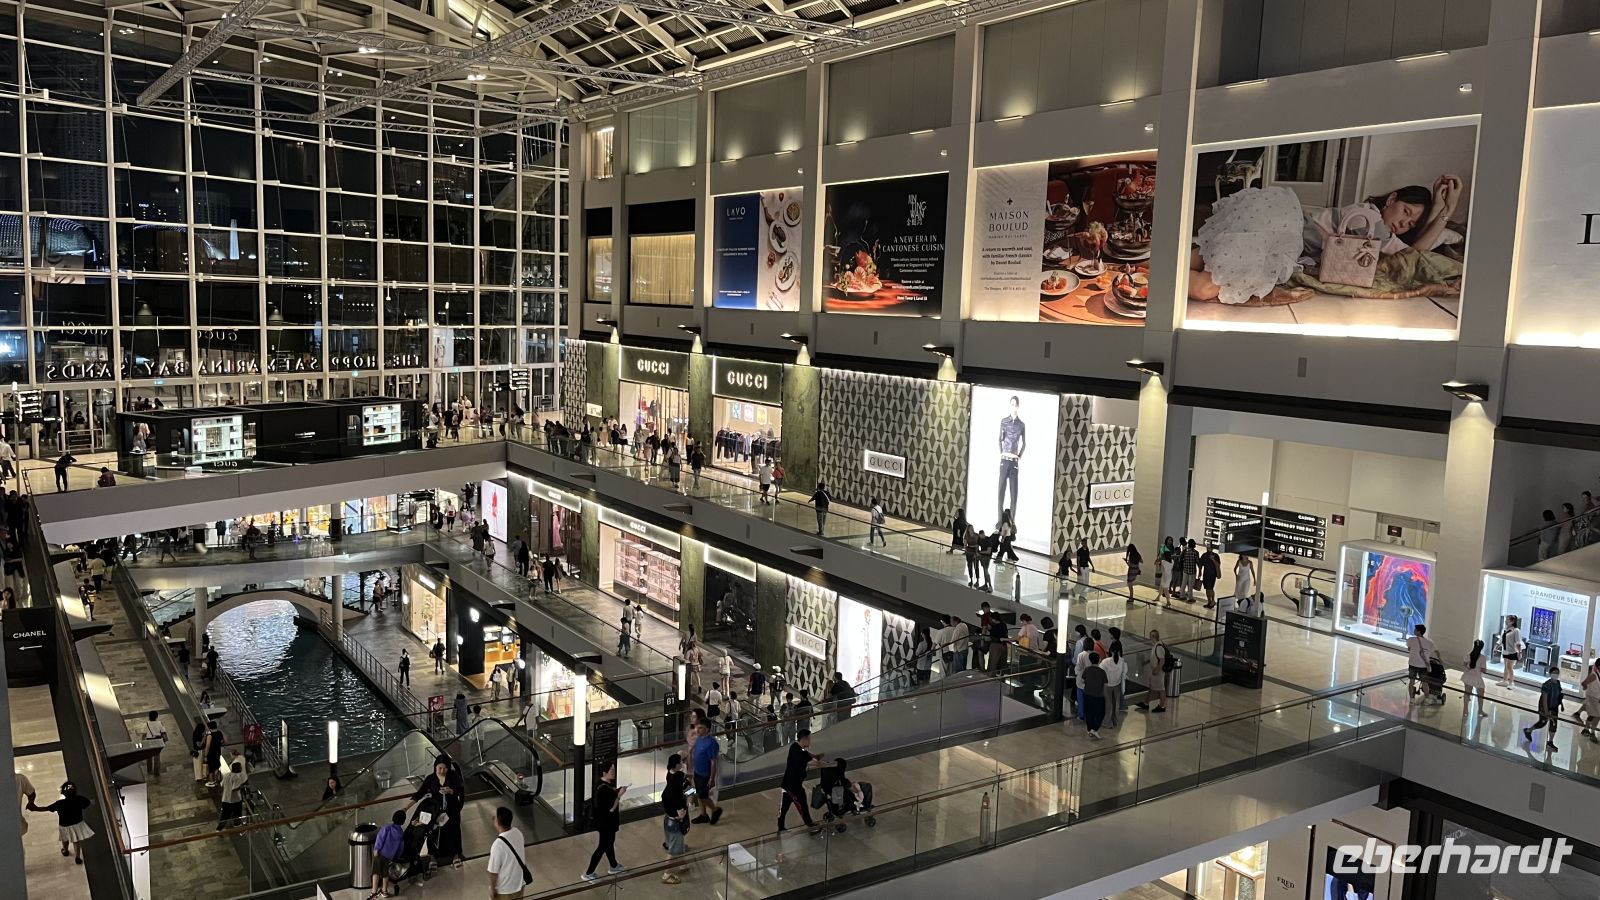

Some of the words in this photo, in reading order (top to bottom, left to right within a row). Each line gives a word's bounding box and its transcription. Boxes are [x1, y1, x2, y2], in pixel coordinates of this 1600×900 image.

[726, 206, 746, 217] LAVO
[990, 211, 1029, 220] MAISON
[988, 222, 1029, 232] BOULUD
[899, 235, 913, 243] NEW
[915, 235, 928, 243] ERA
[929, 234, 938, 242] IN
[882, 244, 920, 252] CANTONESE
[921, 243, 945, 251] CUISIN
[637, 358, 670, 376] GUCCI
[727, 370, 768, 390] GUCCI
[870, 456, 902, 471] GUCCI
[1095, 488, 1131, 500] GUCC
[1298, 514, 1316, 522] CASINO
[1269, 520, 1289, 529] GARDENS
[1293, 535, 1314, 544] SKYPARK
[1530, 589, 1565, 602] GRANDEUR
[1566, 596, 1588, 606] SERIES
[12, 630, 47, 639] CHANEL
[796, 634, 824, 654] GUCCI
[666, 697, 675, 705] B1
[1276, 876, 1295, 889] FRED
